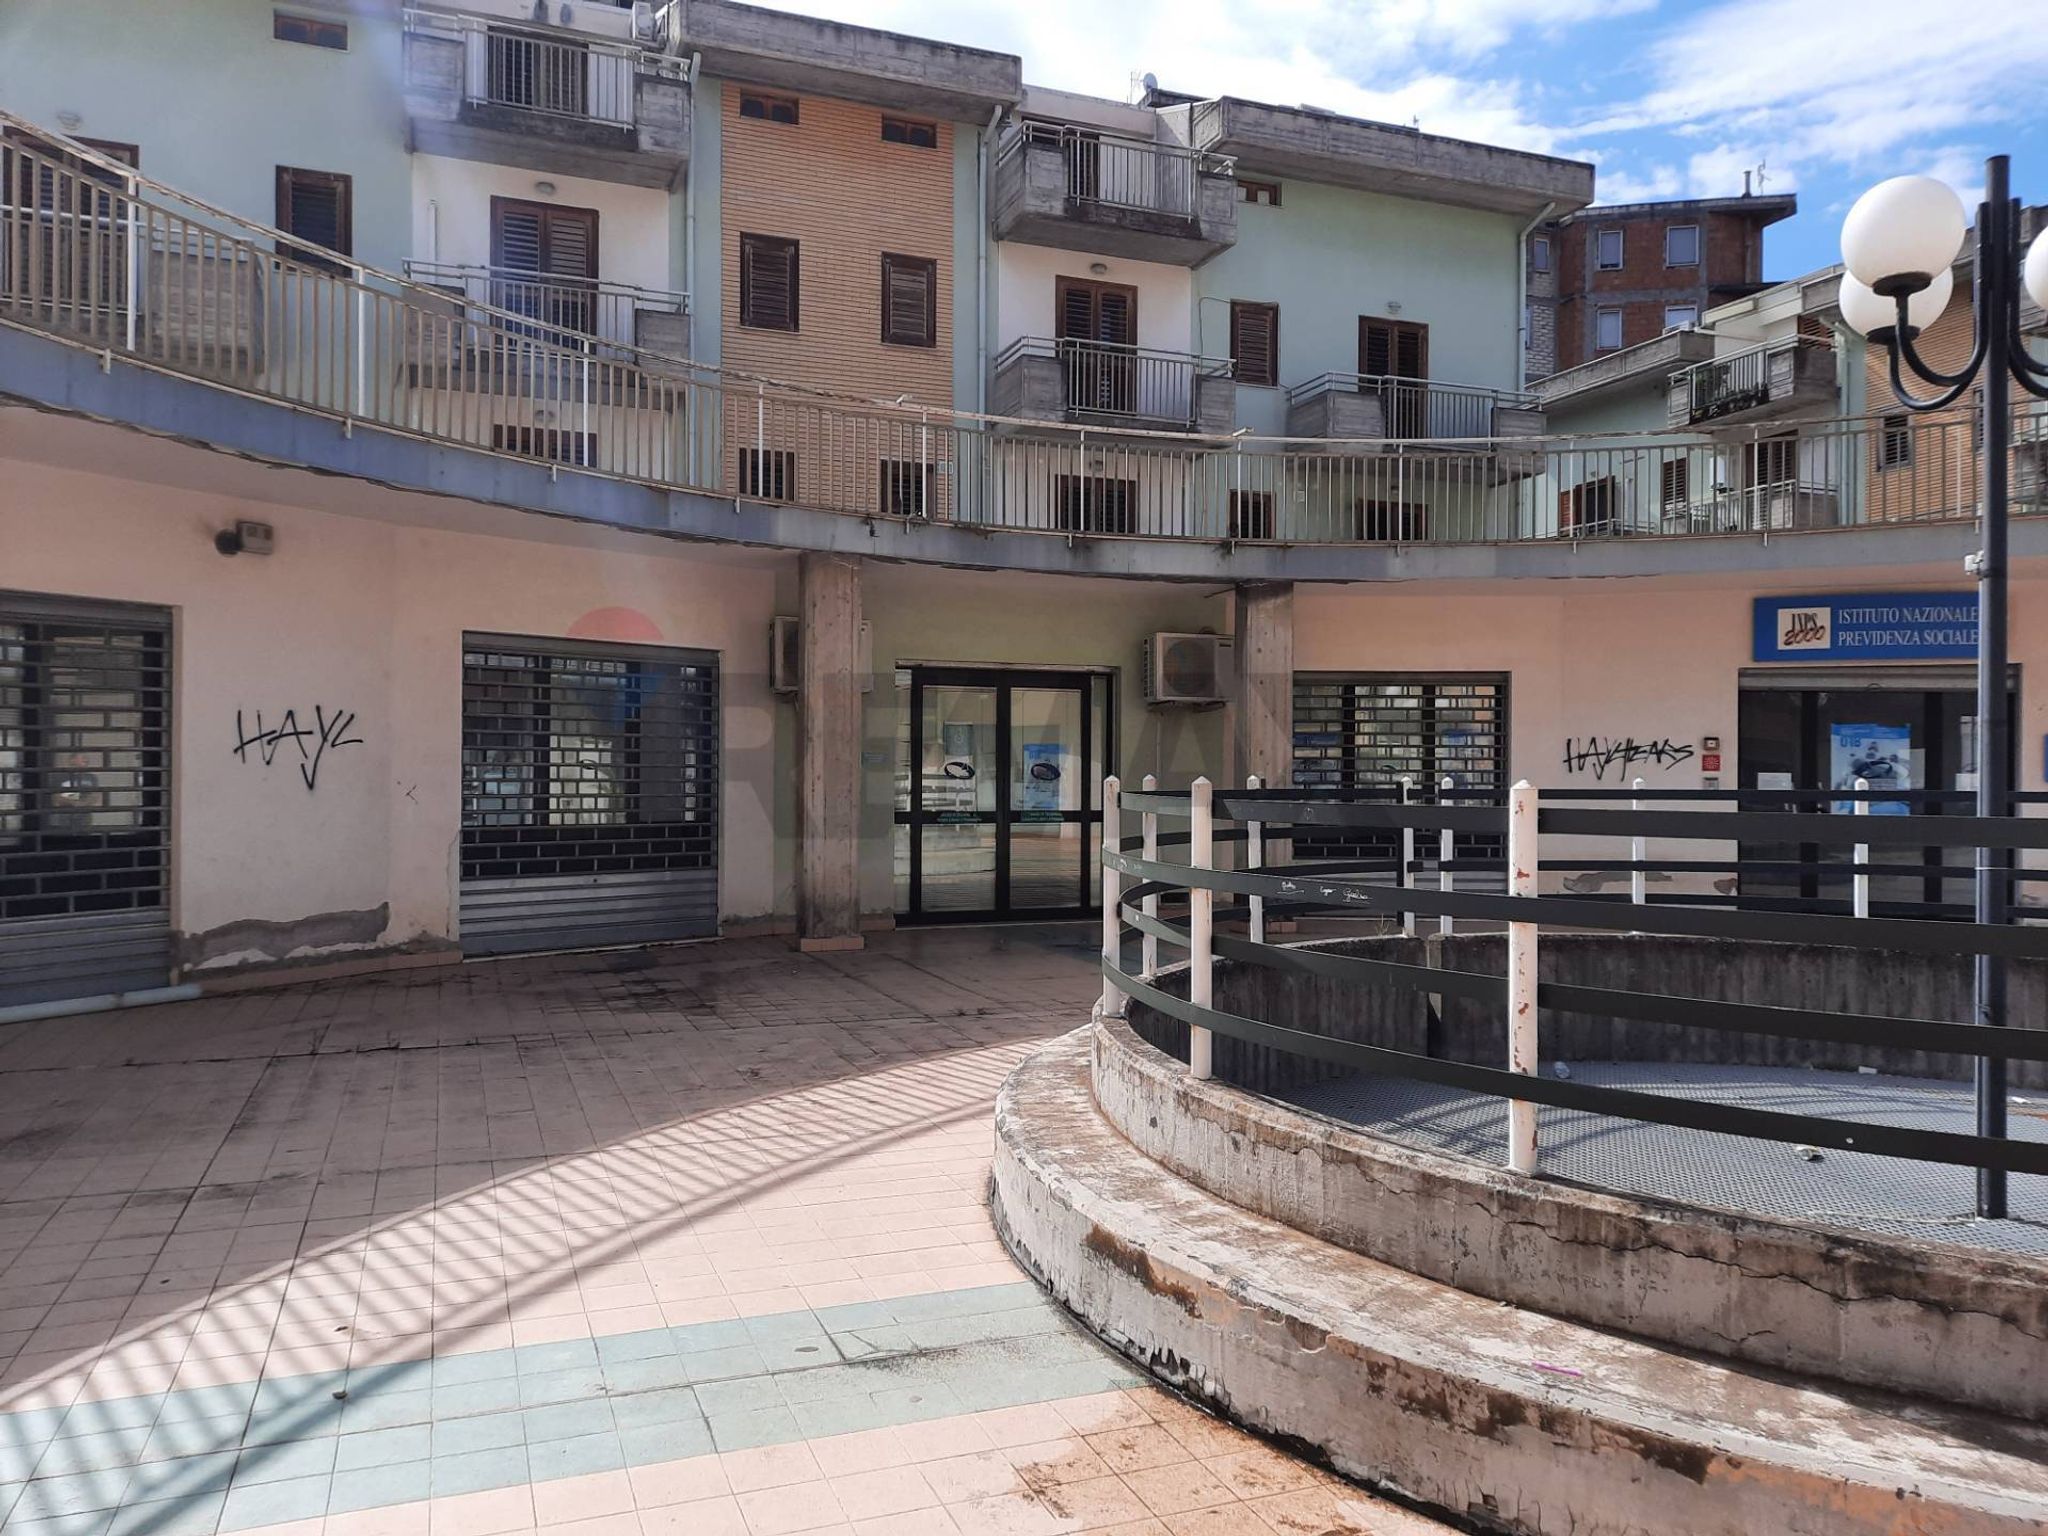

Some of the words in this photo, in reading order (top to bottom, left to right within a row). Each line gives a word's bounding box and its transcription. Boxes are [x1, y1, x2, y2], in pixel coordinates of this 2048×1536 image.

[1839, 607, 1899, 624] ISTITUTO
[1902, 606, 1979, 623] NAZIONALE
[1839, 630, 1920, 646] PREVIDENZA
[1923, 629, 1979, 645] SOCIALE
